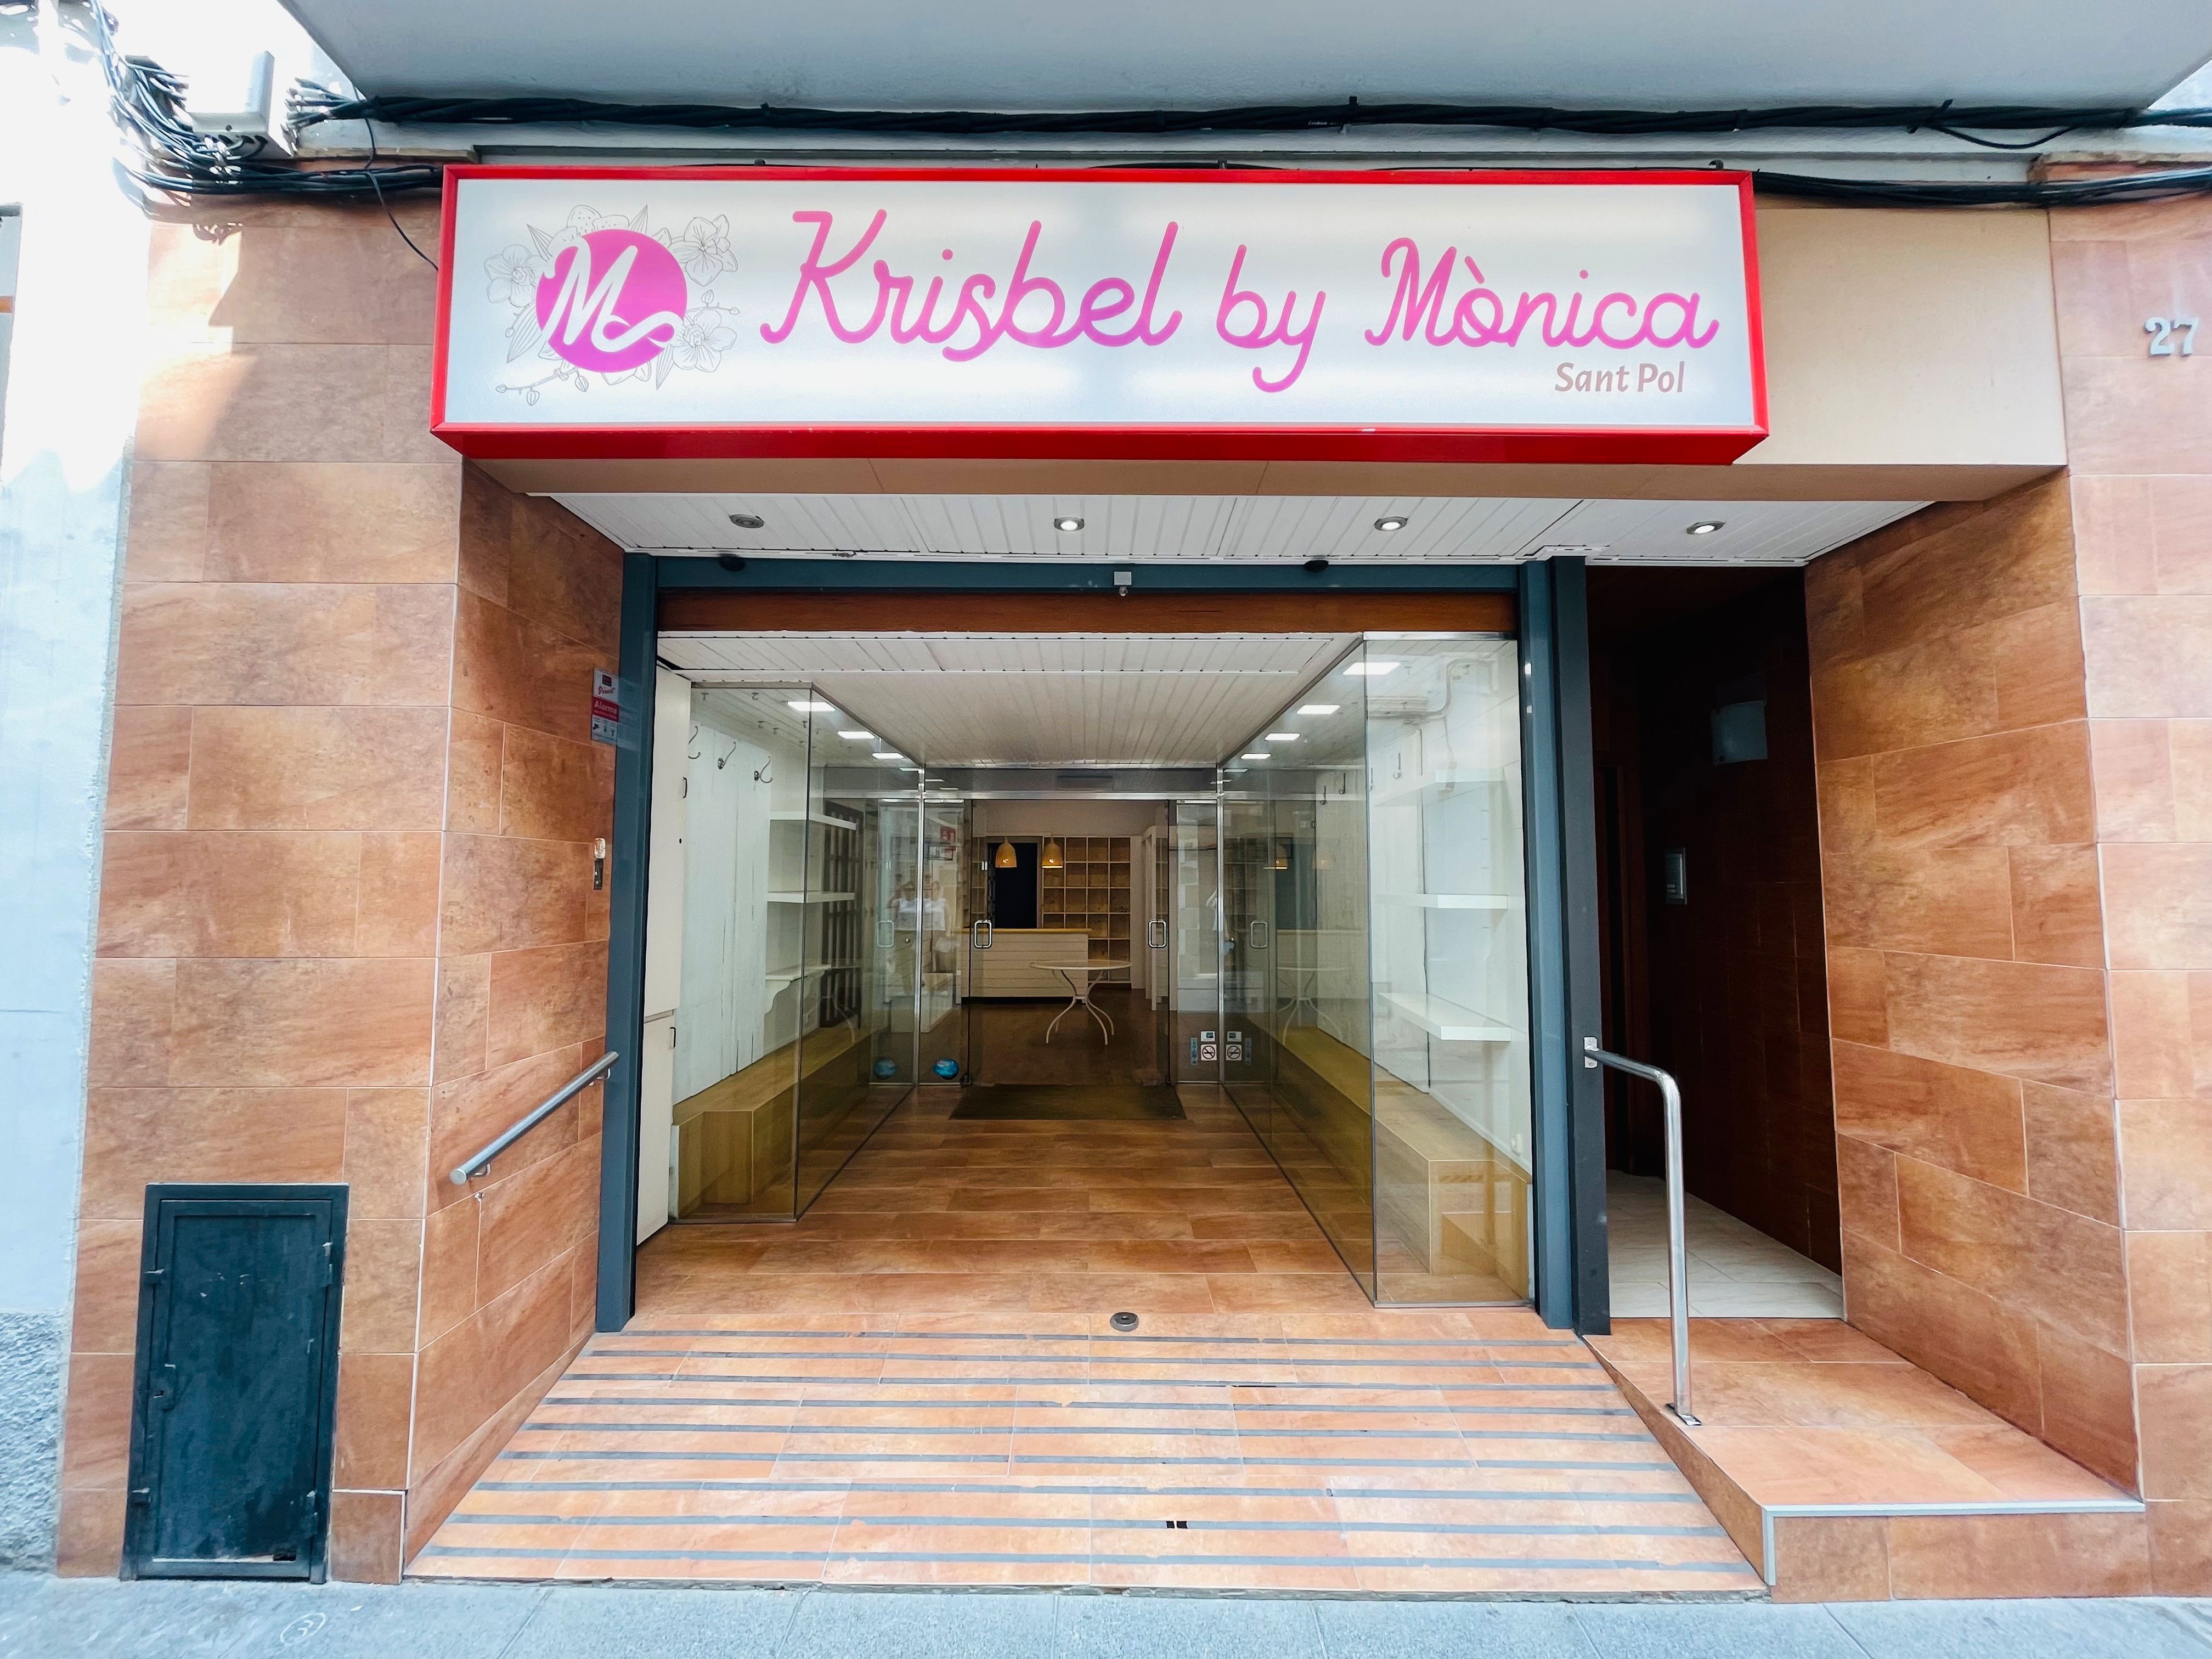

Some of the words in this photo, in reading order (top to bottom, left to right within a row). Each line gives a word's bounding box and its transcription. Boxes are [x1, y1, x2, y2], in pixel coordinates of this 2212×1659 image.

[760, 208, 1182, 362] Krisbel
[1216, 244, 1325, 393] by
[1364, 237, 1719, 349] Mònica
[2145, 317, 2199, 357] 27
[1555, 362, 1629, 392] Sant
[1637, 360, 1685, 393] Pol
[594, 700, 617, 715] Alarma
